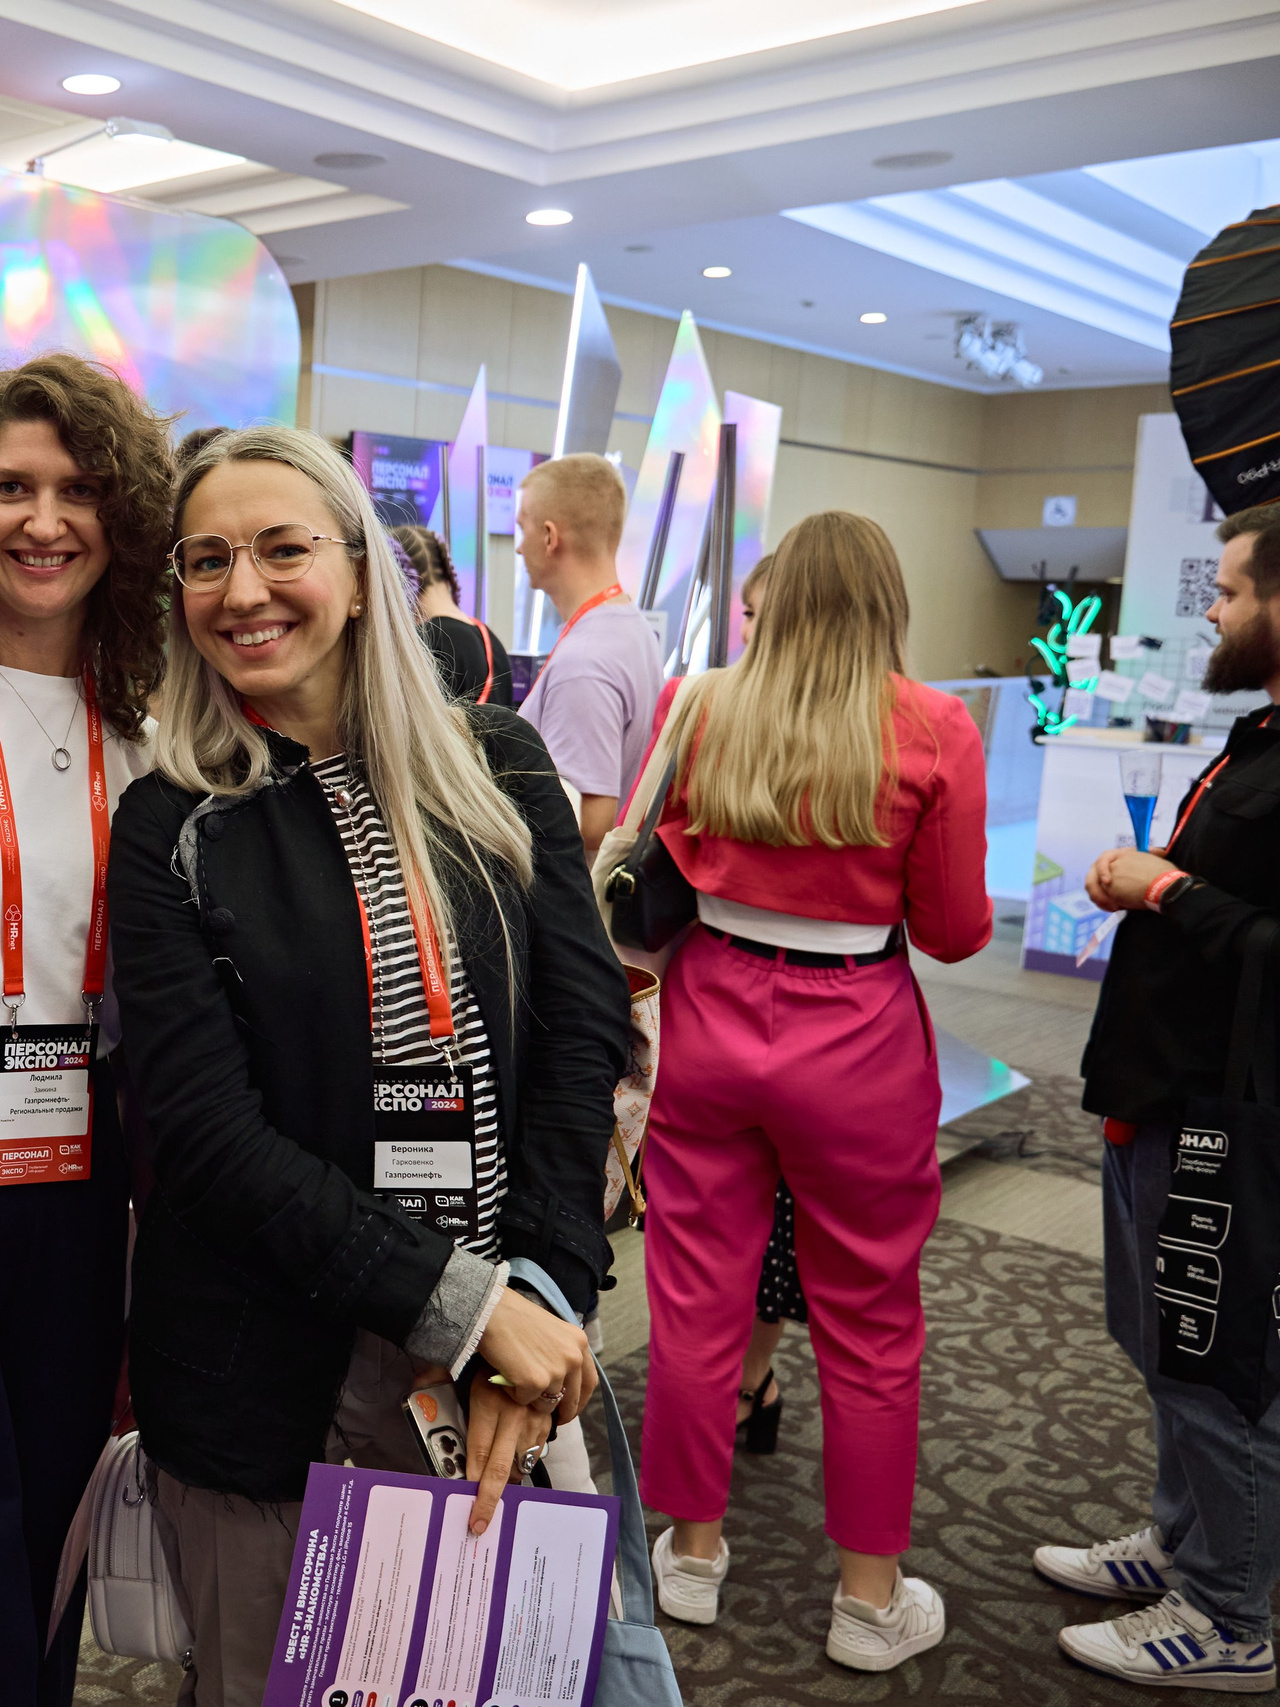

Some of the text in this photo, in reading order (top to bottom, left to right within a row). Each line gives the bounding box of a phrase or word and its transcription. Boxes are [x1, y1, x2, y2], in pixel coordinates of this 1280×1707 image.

[94, 899, 105, 951] ПЕРСОНАЛ
[4, 1041, 91, 1057] ПЕРСОНАЛ
[4, 1055, 84, 1070] ЭКСПО 2024
[30, 1074, 63, 1082] Людмила
[55, 1106, 83, 1114] продажи
[431, 1101, 457, 1109] 2024
[391, 1145, 434, 1154] Вероника
[2, 1150, 49, 1161] ПЕРСОНАЛ
[1, 1167, 24, 1175] ЭКСПО
[385, 1171, 442, 1179] Газпромнефть
[285, 1529, 318, 1662] КВЕСТ И ВИКТОРИНА
[299, 1536, 327, 1657] «HR-ЗНАКОМСТВА»
